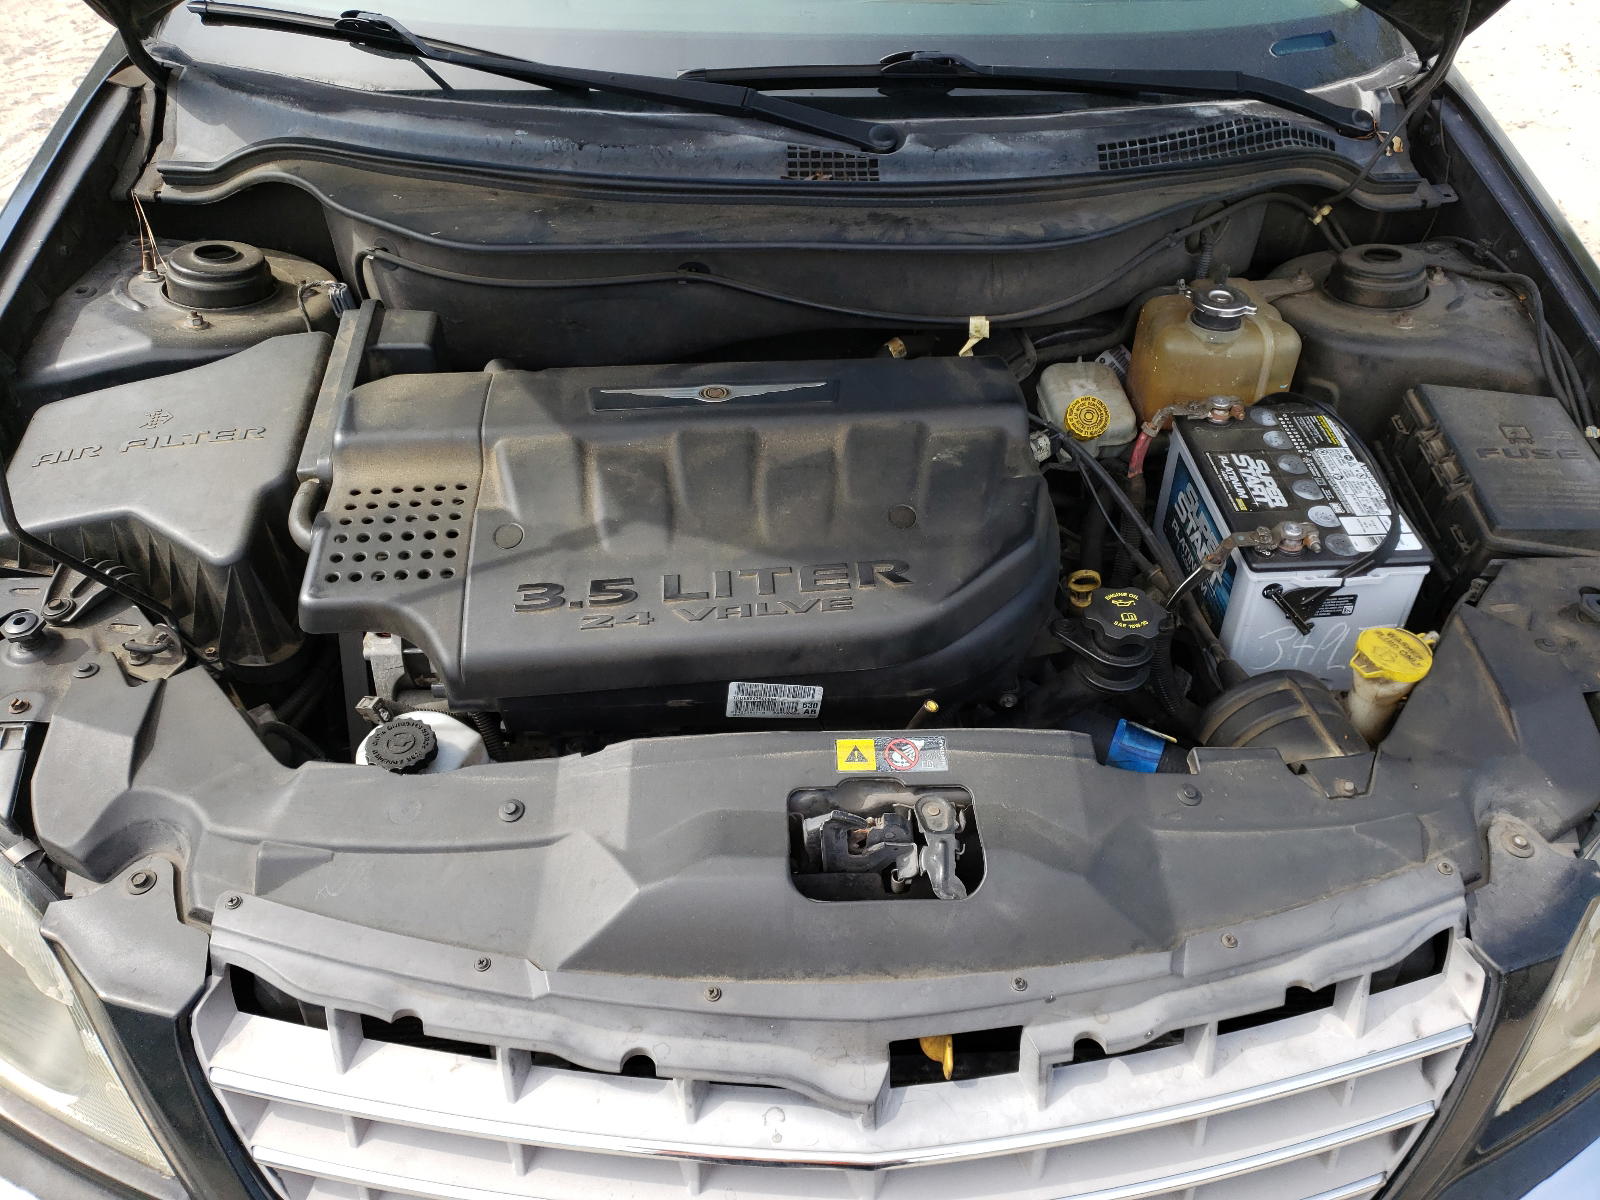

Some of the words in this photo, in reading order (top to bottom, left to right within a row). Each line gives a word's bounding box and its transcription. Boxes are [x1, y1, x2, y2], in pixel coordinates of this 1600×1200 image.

[32, 445, 102, 467] AIR
[120, 427, 266, 453] FILTER
[1476, 447, 1581, 460] FUSE
[1218, 455, 1249, 499] PLATINUM
[1230, 453, 1276, 508] START
[1255, 459, 1288, 507] SUPER
[513, 577, 638, 612] 3.5
[662, 560, 913, 603] LITER
[1105, 592, 1127, 601] ENGINE
[1128, 593, 1139, 601] OIL
[580, 612, 655, 631] 24
[674, 597, 853, 622] VALVE
